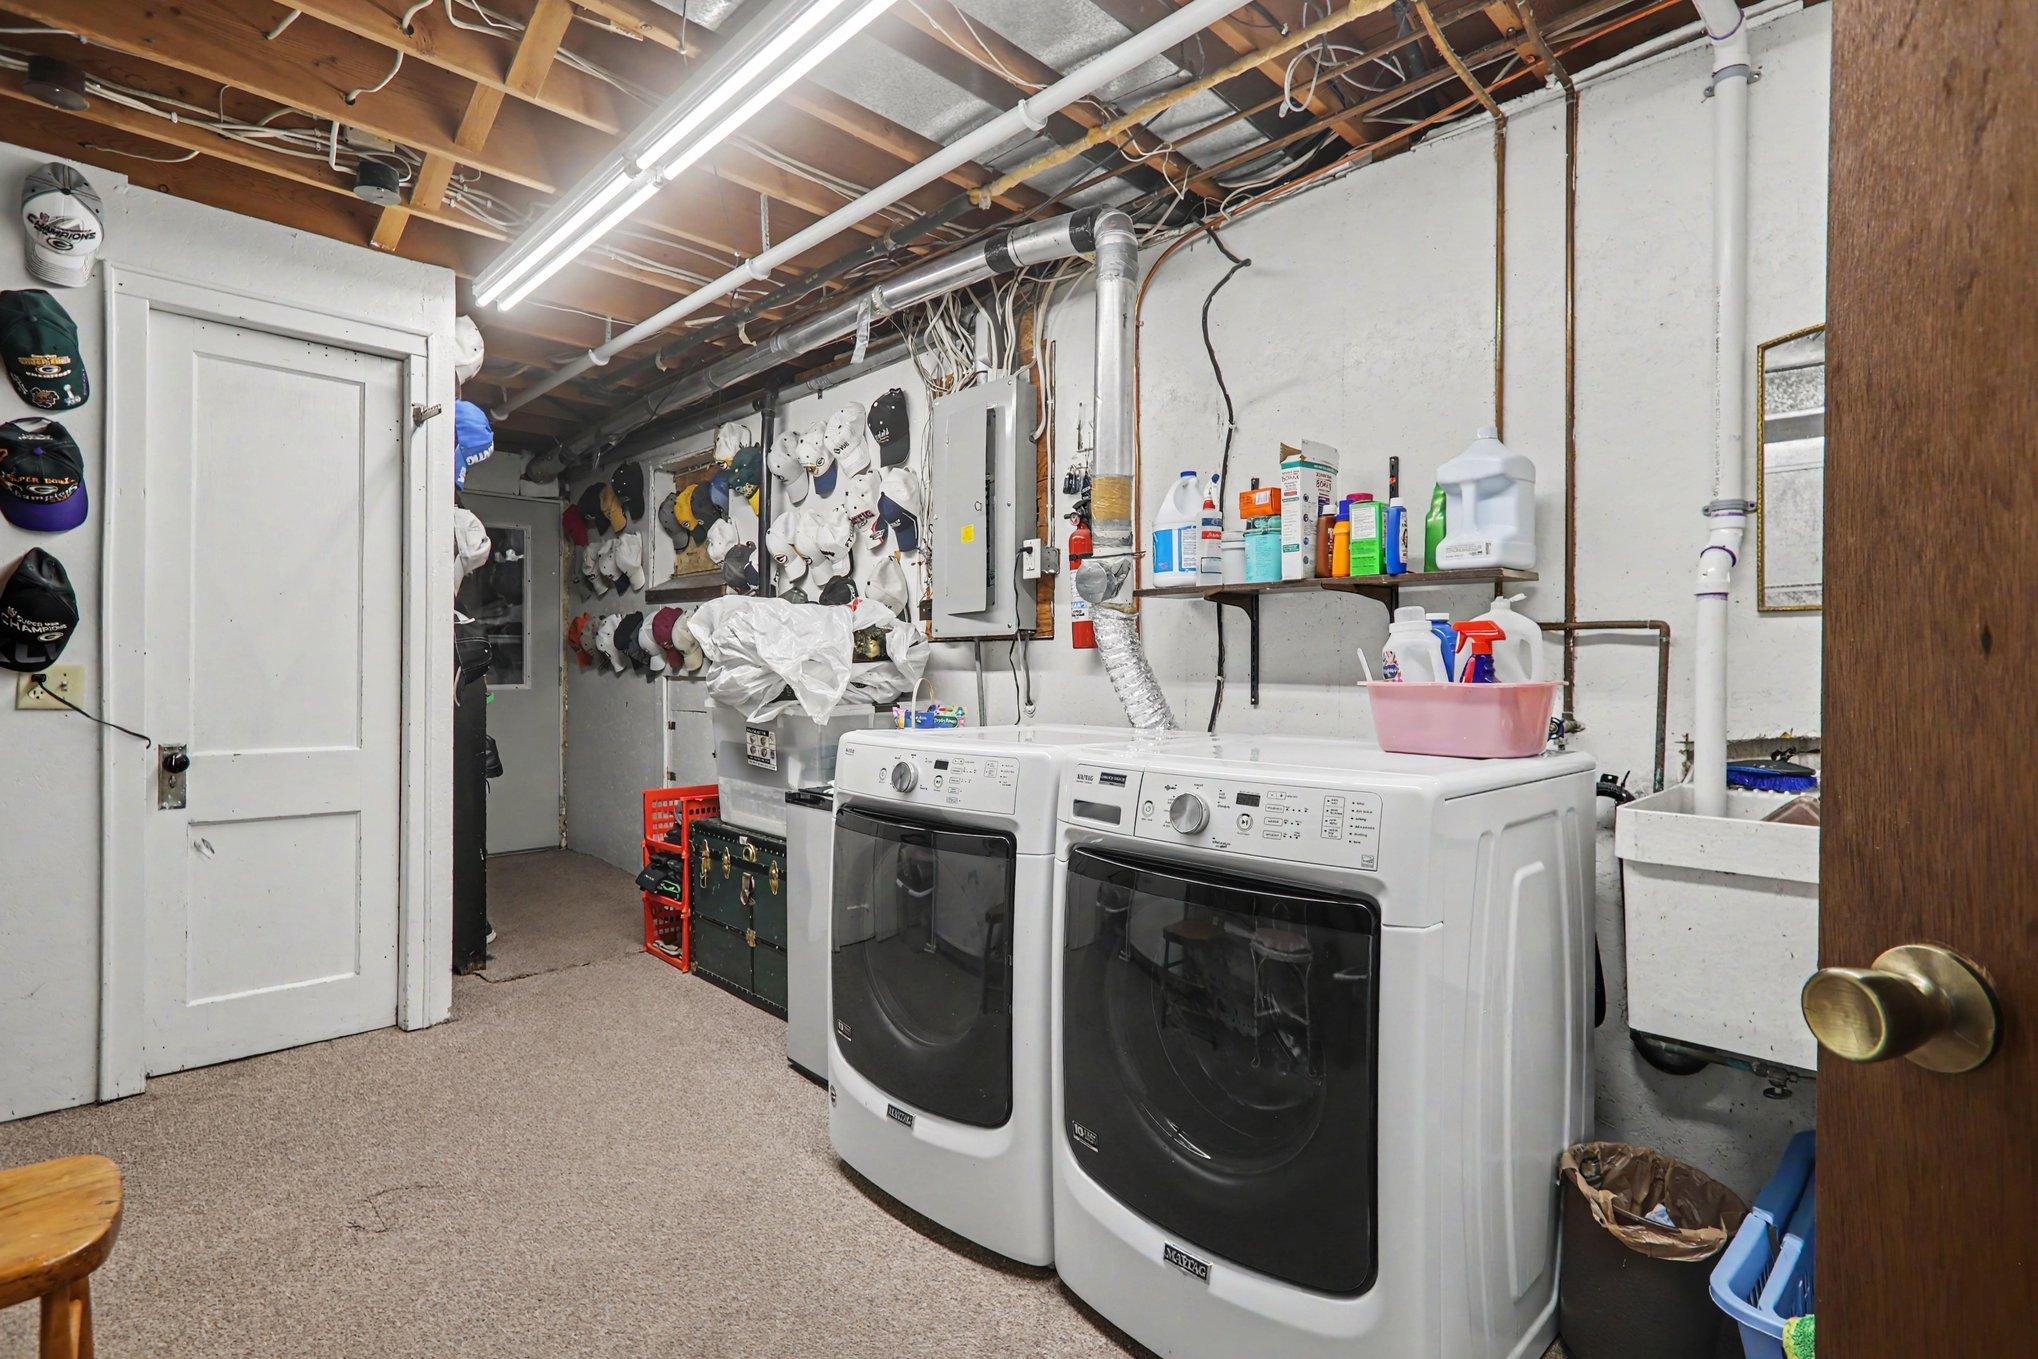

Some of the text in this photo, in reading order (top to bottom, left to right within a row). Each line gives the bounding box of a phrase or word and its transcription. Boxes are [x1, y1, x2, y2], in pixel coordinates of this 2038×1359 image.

[27, 213, 97, 240] CHAMPIONS
[1, 612, 68, 634] CHAMPIONS
[1164, 1246, 1208, 1279] MAYTAG
